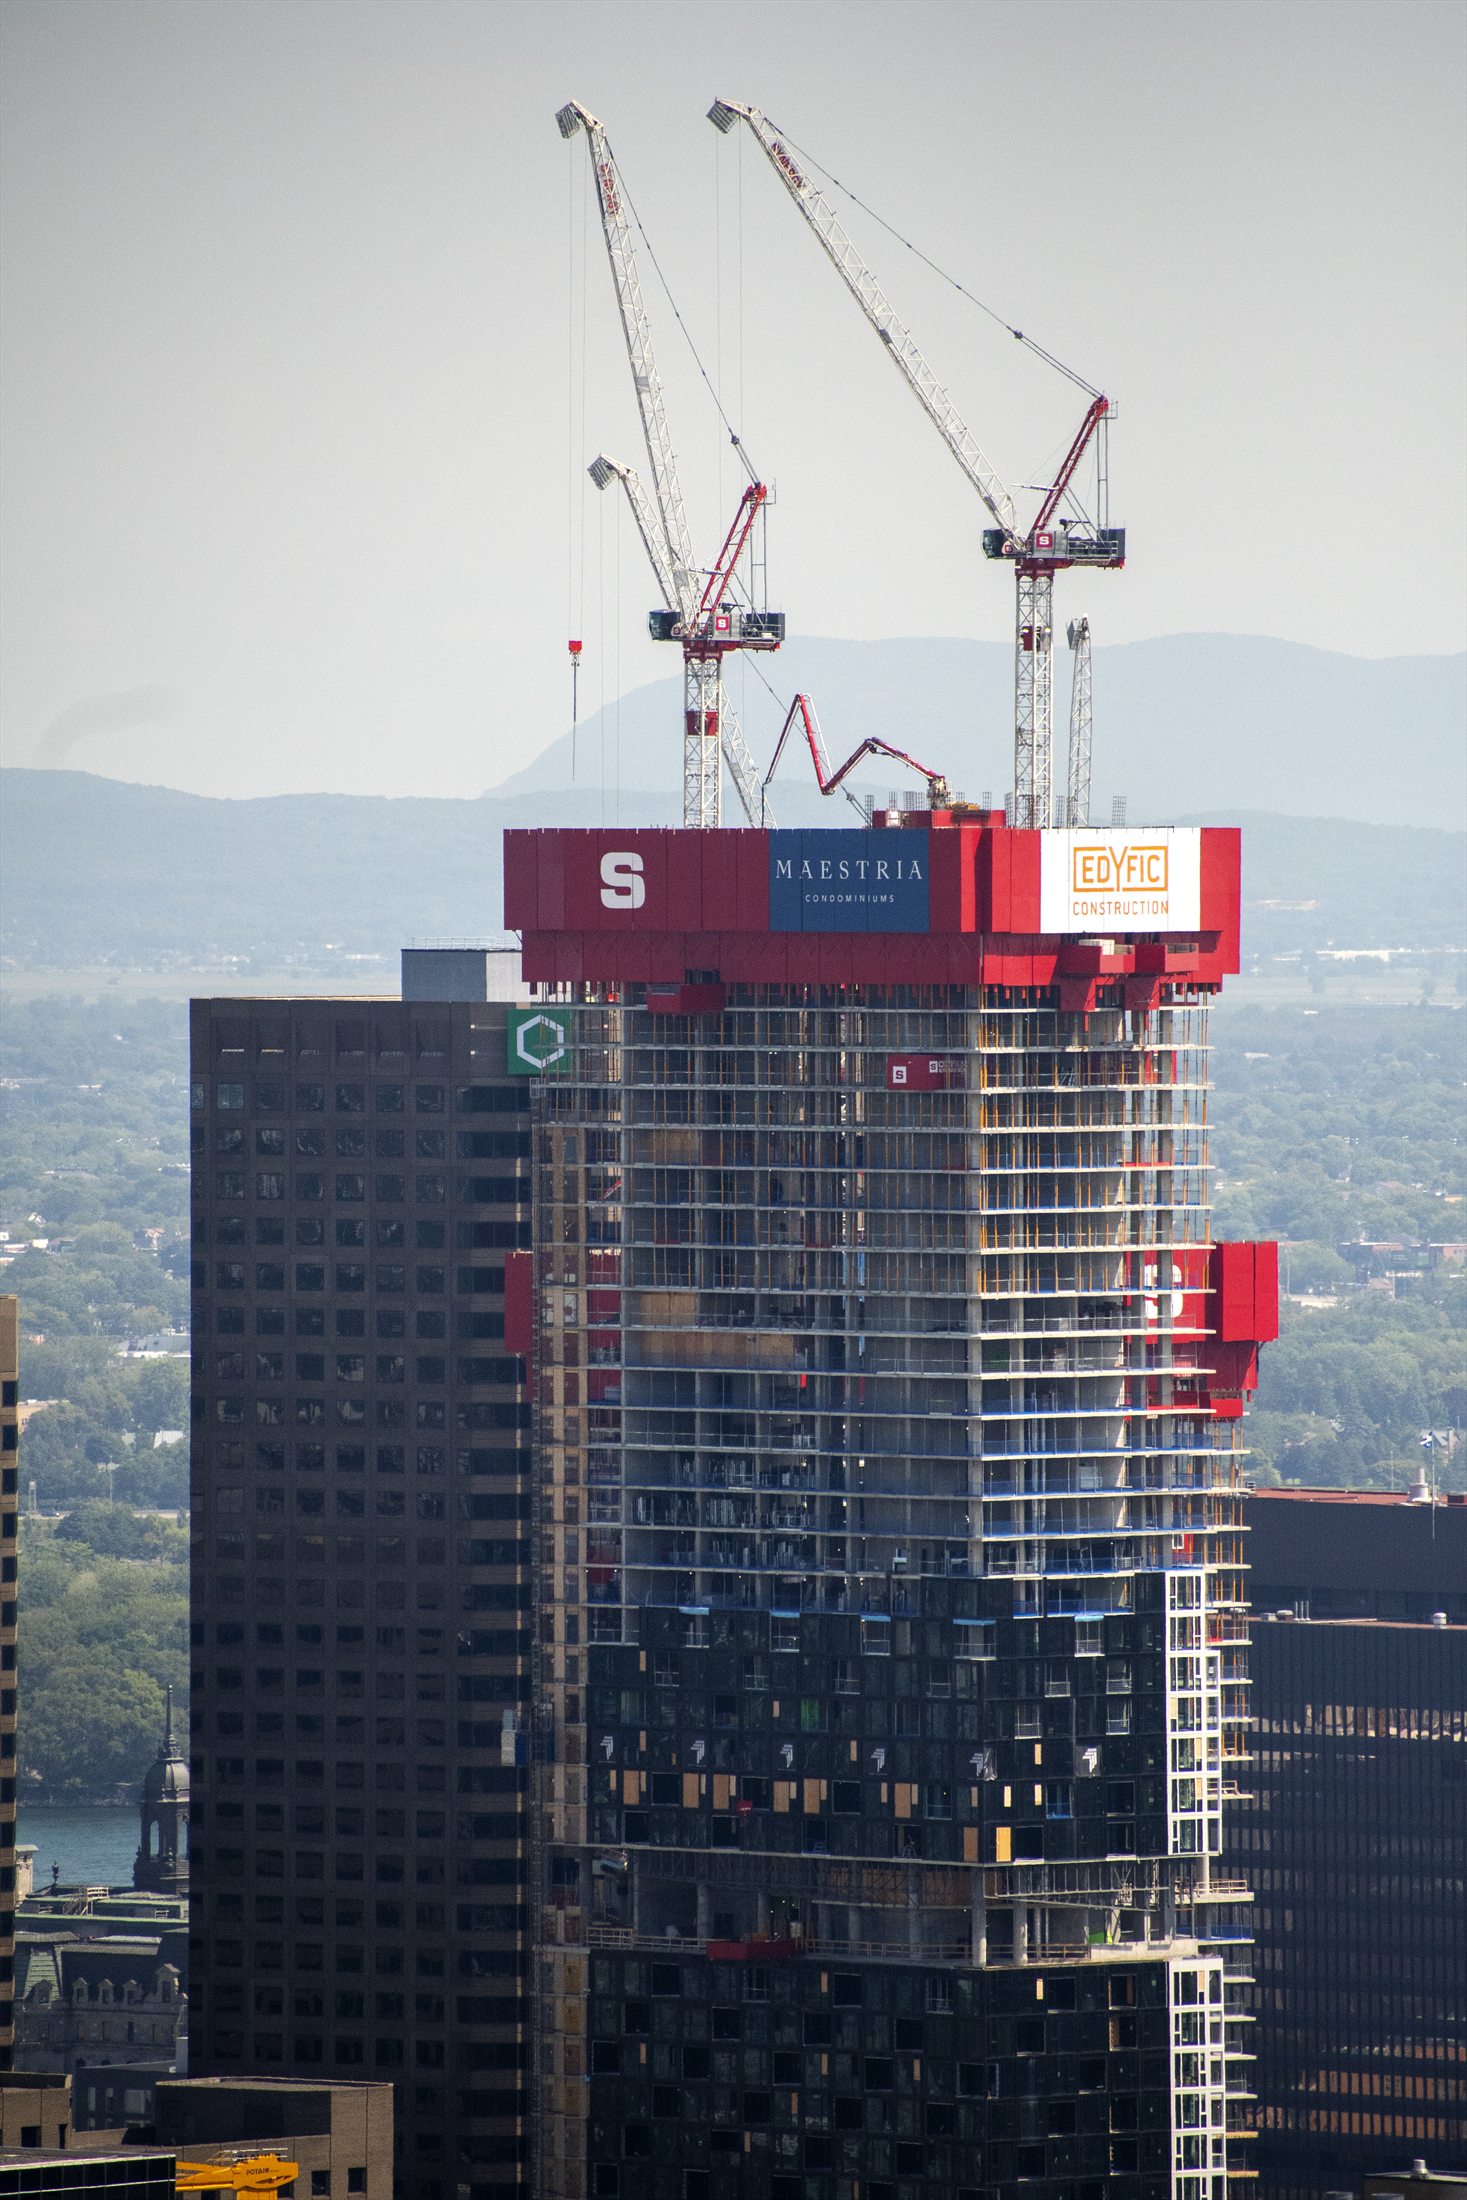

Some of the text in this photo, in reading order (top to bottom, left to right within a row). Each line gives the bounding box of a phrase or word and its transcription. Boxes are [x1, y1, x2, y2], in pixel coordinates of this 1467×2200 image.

[1039, 536, 1050, 545] S
[718, 619, 727, 628] S
[775, 859, 923, 880] MAESTRIA
[1082, 846, 1161, 892] EDYFIC
[600, 851, 646, 909] S
[805, 894, 895, 903] CONDOMINIUMS
[1072, 900, 1169, 916] CONSTRUCTION
[895, 1070, 904, 1080] S
